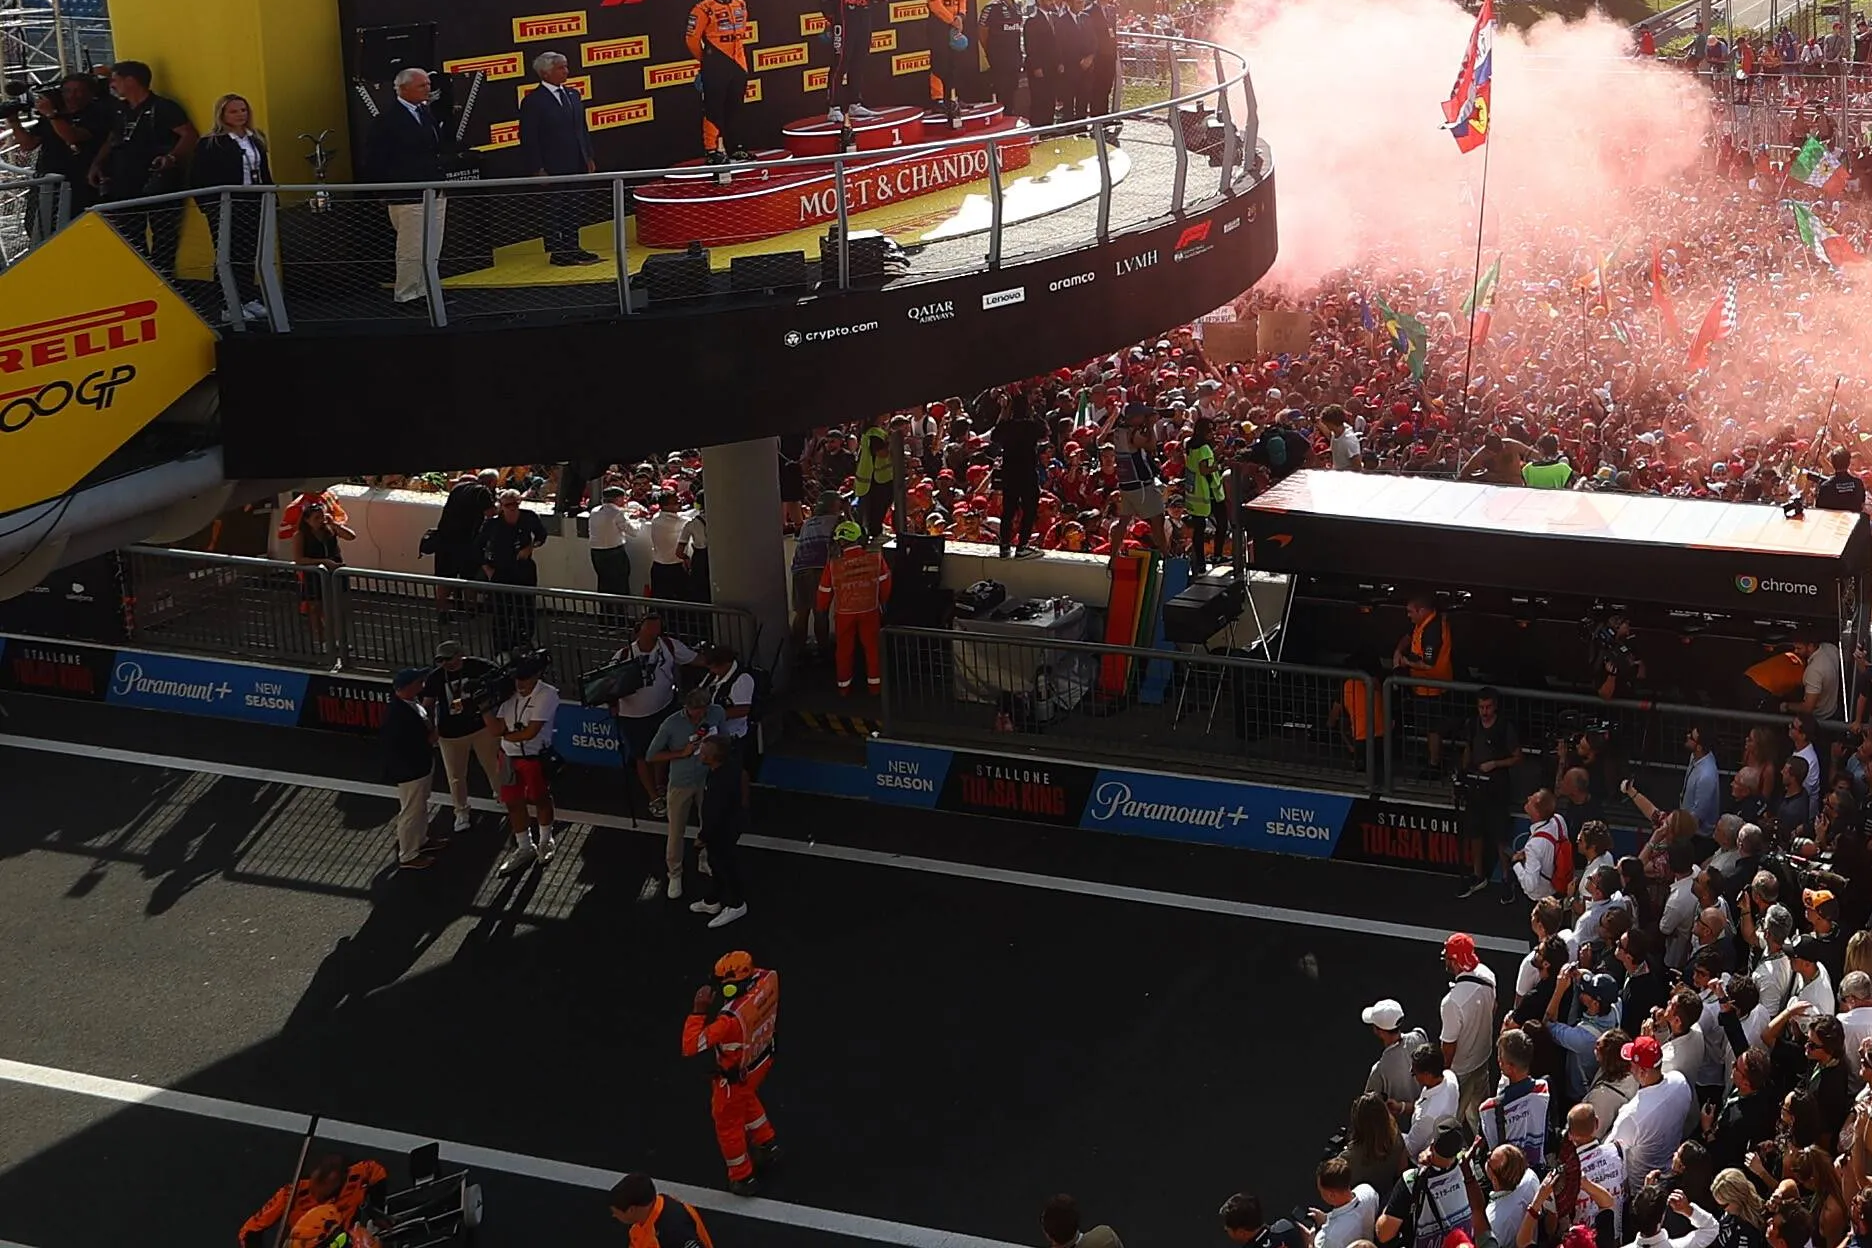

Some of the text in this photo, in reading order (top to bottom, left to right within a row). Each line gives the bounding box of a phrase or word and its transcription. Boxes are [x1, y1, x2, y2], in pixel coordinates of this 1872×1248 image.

[519, 15, 581, 37] PIRELLI
[586, 40, 644, 62] PIRELLI
[757, 46, 804, 67] PIRELLI
[592, 102, 648, 127] PIRELLI
[891, 128, 902, 146] 1
[761, 170, 770, 181] 2
[877, 172, 899, 202] &
[1115, 249, 1158, 276] LVMH
[1049, 271, 1096, 292] aramco
[986, 292, 1022, 305] Lenovo
[907, 300, 954, 320] QATAR
[919, 311, 955, 324] AIRWAYS
[805, 320, 879, 342] crypto.com
[1761, 577, 1818, 596] chrome
[23, 648, 82, 666] STALLONE
[113, 660, 233, 704] Paramount+
[254, 681, 283, 696] NEW
[244, 694, 295, 712] SEASON
[329, 686, 392, 705] STALLONE
[582, 720, 613, 736] NEW
[887, 759, 920, 776] NEW
[975, 764, 1051, 786] STALLONE
[876, 773, 934, 793] SEASON
[1090, 780, 1250, 830] Paramount+
[1279, 806, 1315, 824] NEW
[1265, 820, 1330, 841] SEASON
[1360, 821, 1425, 861] TULSA
